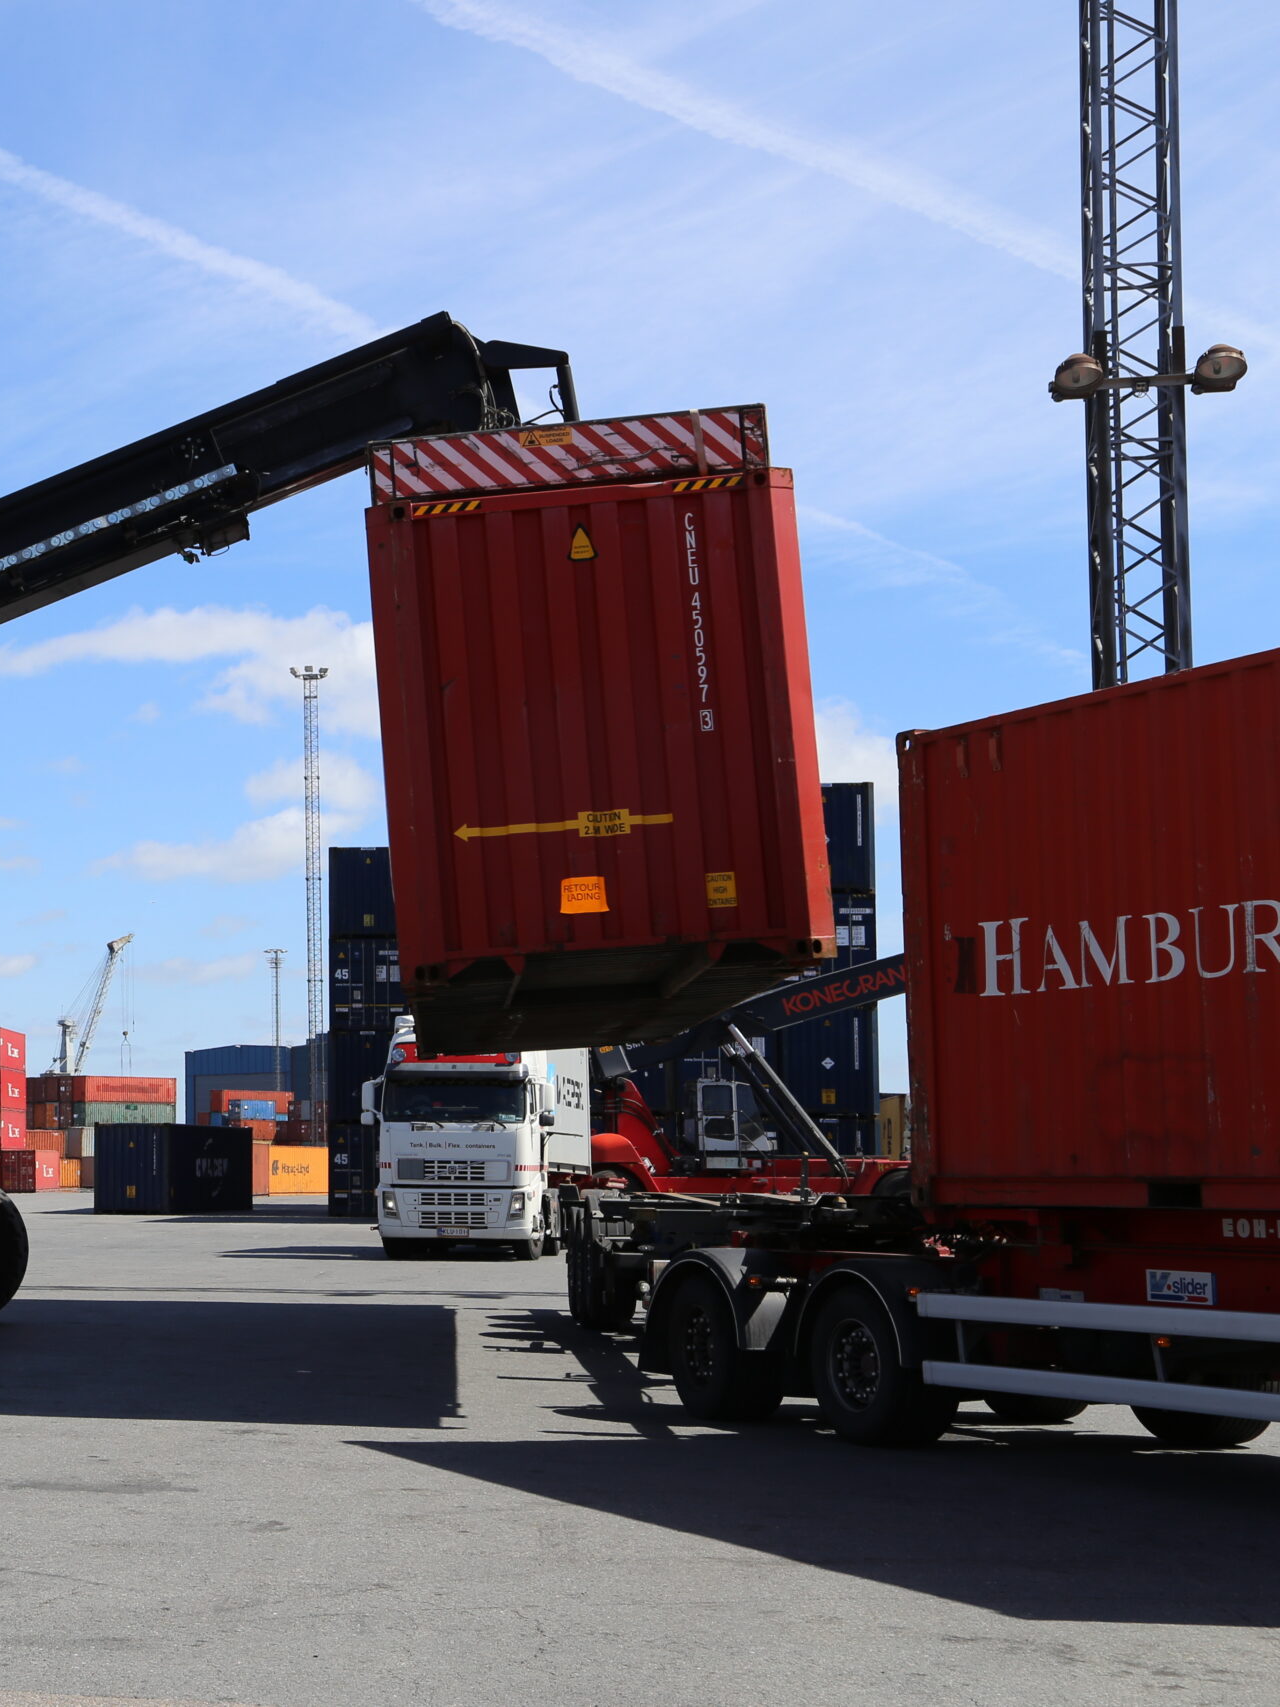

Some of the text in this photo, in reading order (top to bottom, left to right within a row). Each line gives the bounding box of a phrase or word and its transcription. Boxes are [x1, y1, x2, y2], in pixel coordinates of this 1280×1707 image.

[684, 512, 713, 730] CNEU 450597 3
[563, 882, 601, 894] RETOUR
[567, 892, 601, 903] LADING
[978, 899, 1280, 997] HAMBUR
[334, 968, 349, 980] 45
[782, 964, 906, 1016] KONECRAN
[333, 1153, 348, 1165] 45
[1221, 1218, 1280, 1239] EOH-
[1172, 1277, 1208, 1295] slider
